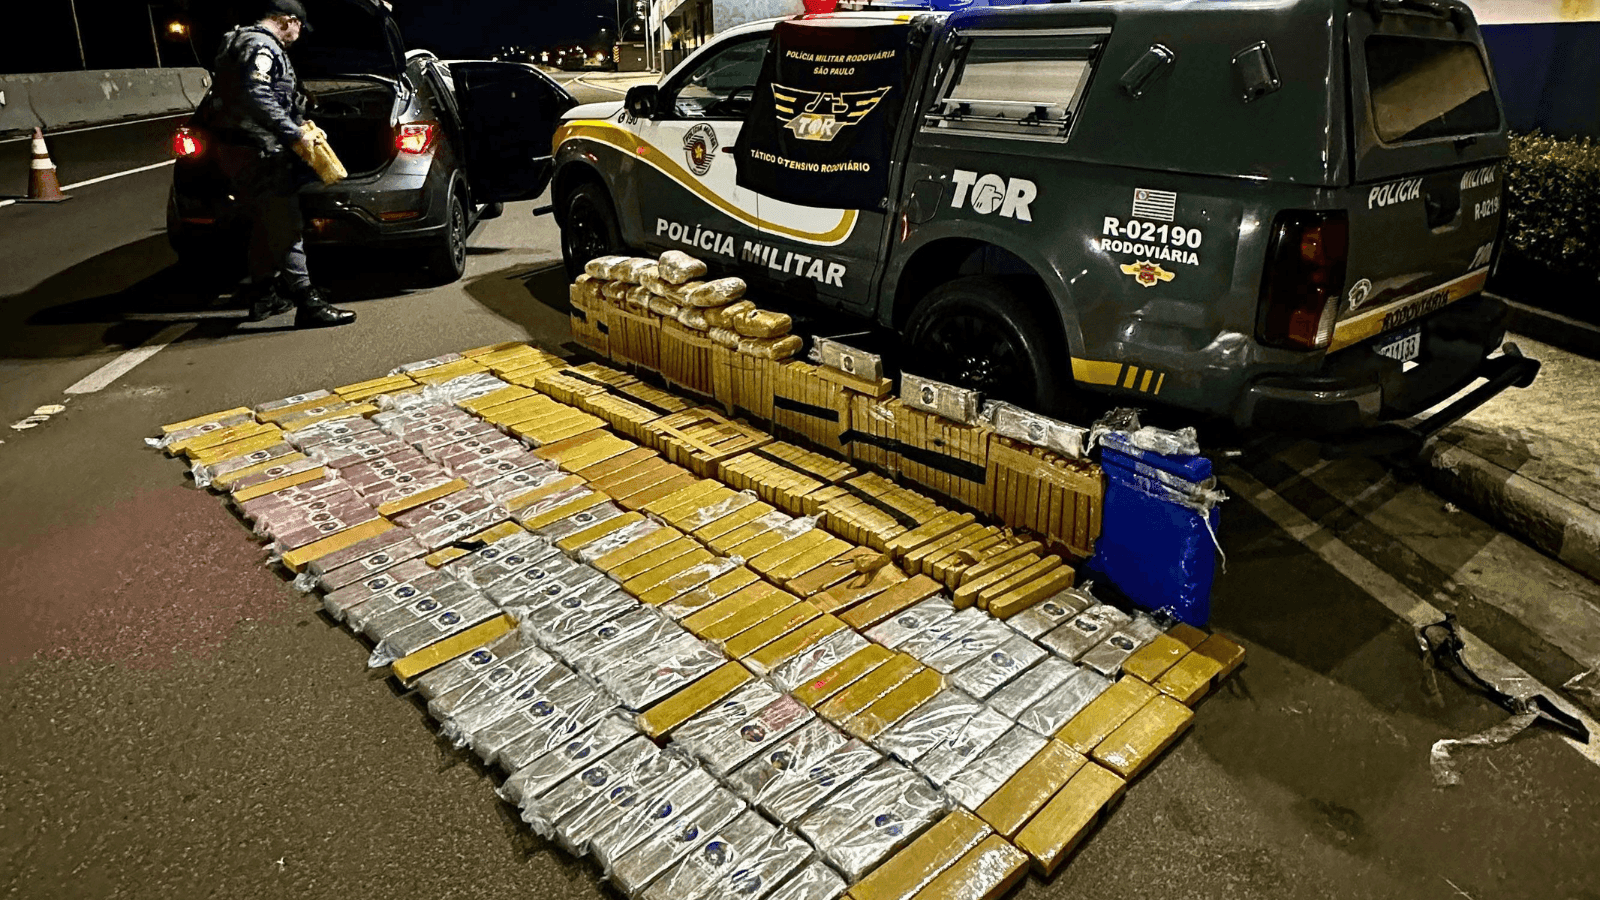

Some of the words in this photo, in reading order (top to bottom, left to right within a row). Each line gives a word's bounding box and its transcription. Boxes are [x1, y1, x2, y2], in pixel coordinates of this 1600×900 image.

[786, 50, 814, 61] POLÍCIA
[846, 50, 895, 62] RODOVIÁRIA
[813, 65, 829, 75] SÃO
[829, 67, 855, 75] PAULO
[798, 117, 835, 136] TOR
[751, 149, 776, 163] TÁTICO
[950, 169, 1037, 222] TOR
[1368, 177, 1424, 210] POLÍCIA
[1474, 196, 1500, 220] R-0219
[1102, 216, 1202, 249] R-02190
[656, 218, 735, 257] POLÍCIA
[741, 240, 847, 288] MILITAR
[1100, 238, 1199, 266] RODOVIÁRIA
